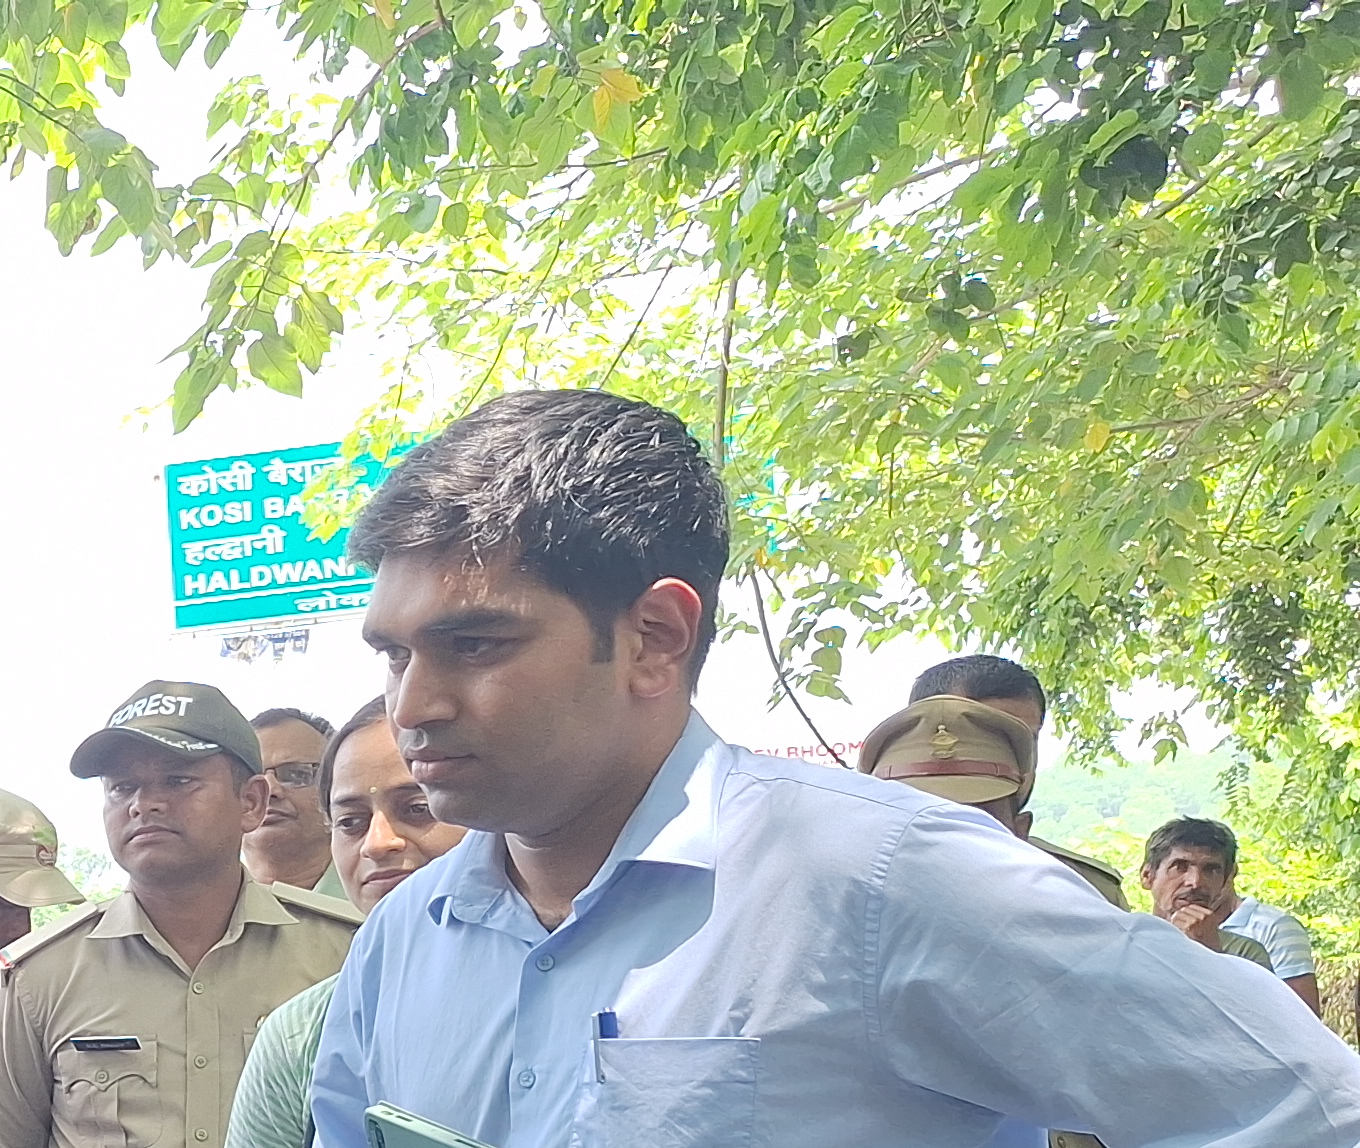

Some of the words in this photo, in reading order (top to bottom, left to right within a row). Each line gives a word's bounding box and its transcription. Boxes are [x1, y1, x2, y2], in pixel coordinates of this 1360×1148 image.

[177, 460, 256, 497] कोसी
[261, 457, 343, 487] बैरा
[178, 501, 253, 530] KOSI
[181, 524, 288, 565] हल्द्वानी
[109, 693, 194, 728] FOREST
